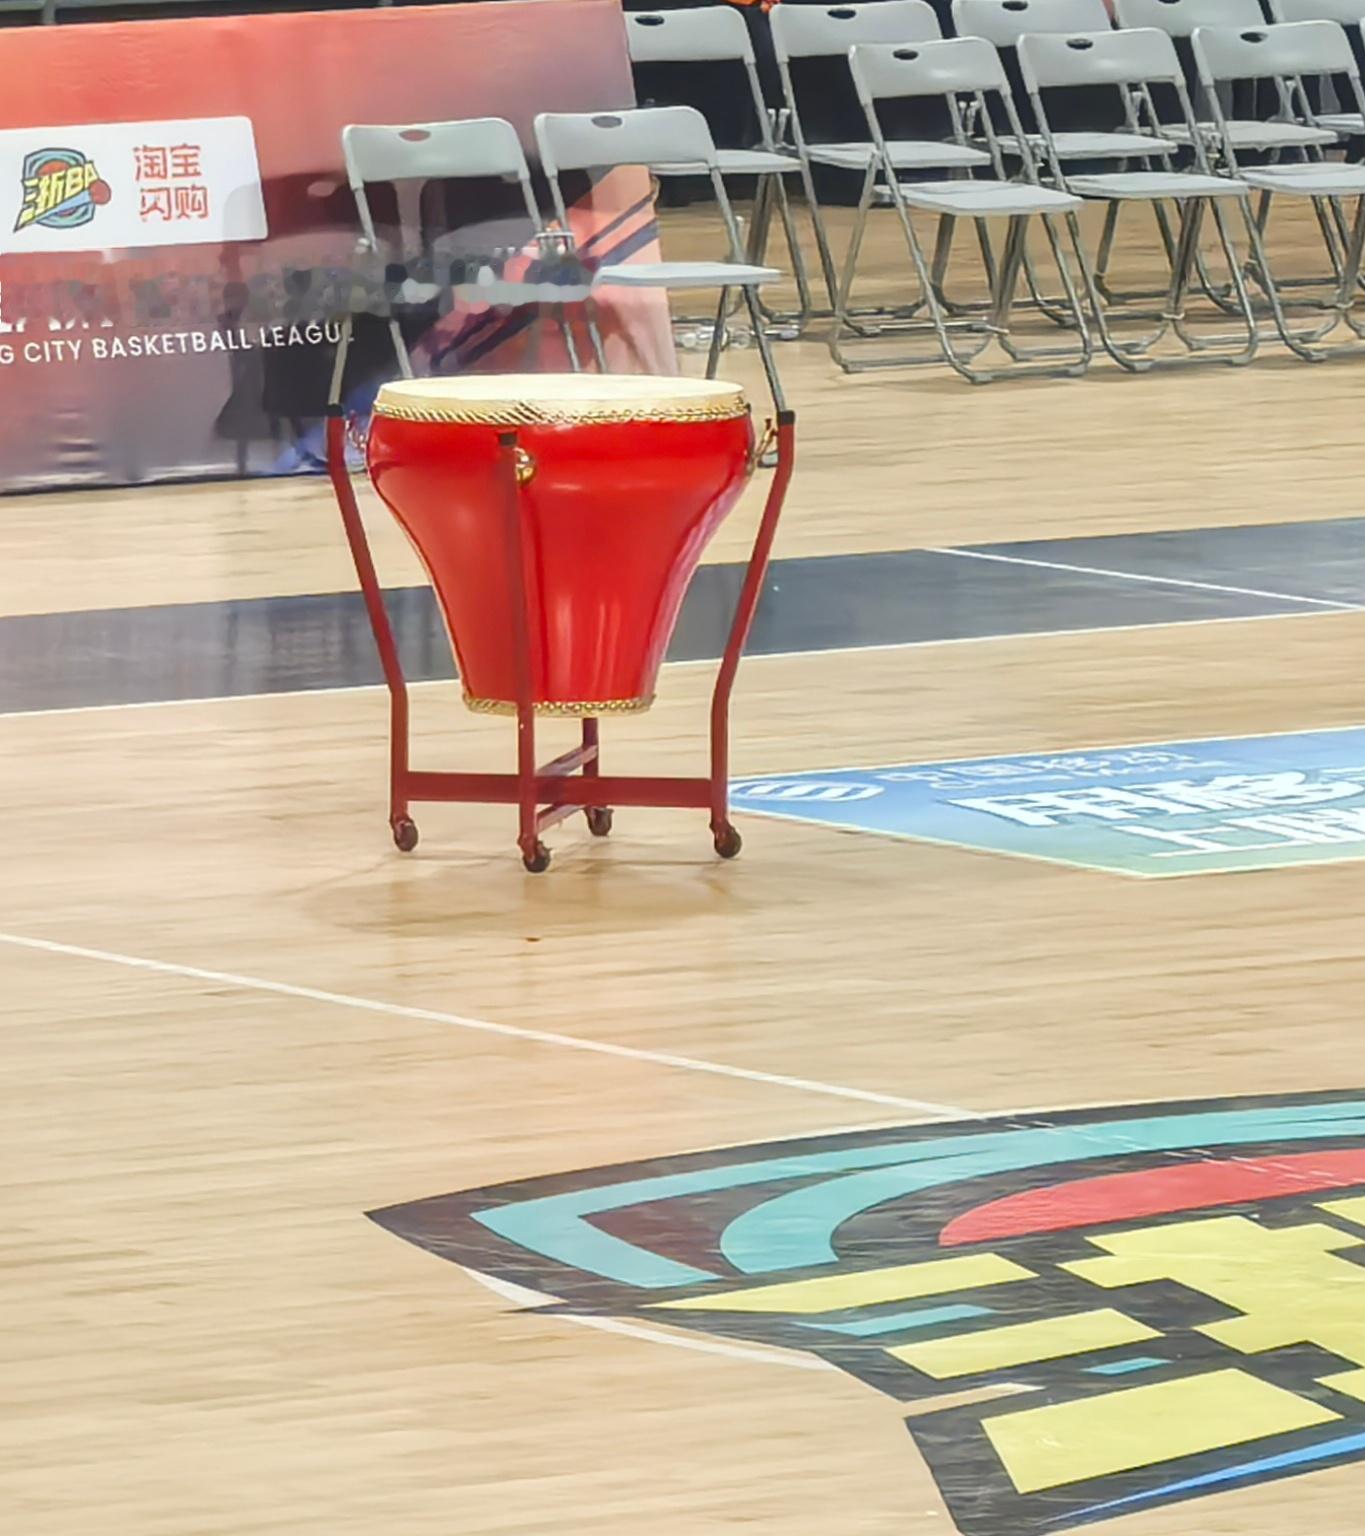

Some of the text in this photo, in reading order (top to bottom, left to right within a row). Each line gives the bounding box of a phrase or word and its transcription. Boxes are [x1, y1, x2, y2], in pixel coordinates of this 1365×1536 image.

[133, 143, 202, 182] 淘宝
[139, 184, 209, 223] 闪购
[24, 340, 83, 363] CITY
[93, 329, 252, 359] BASKETBALL
[260, 320, 355, 348] LEAGU
